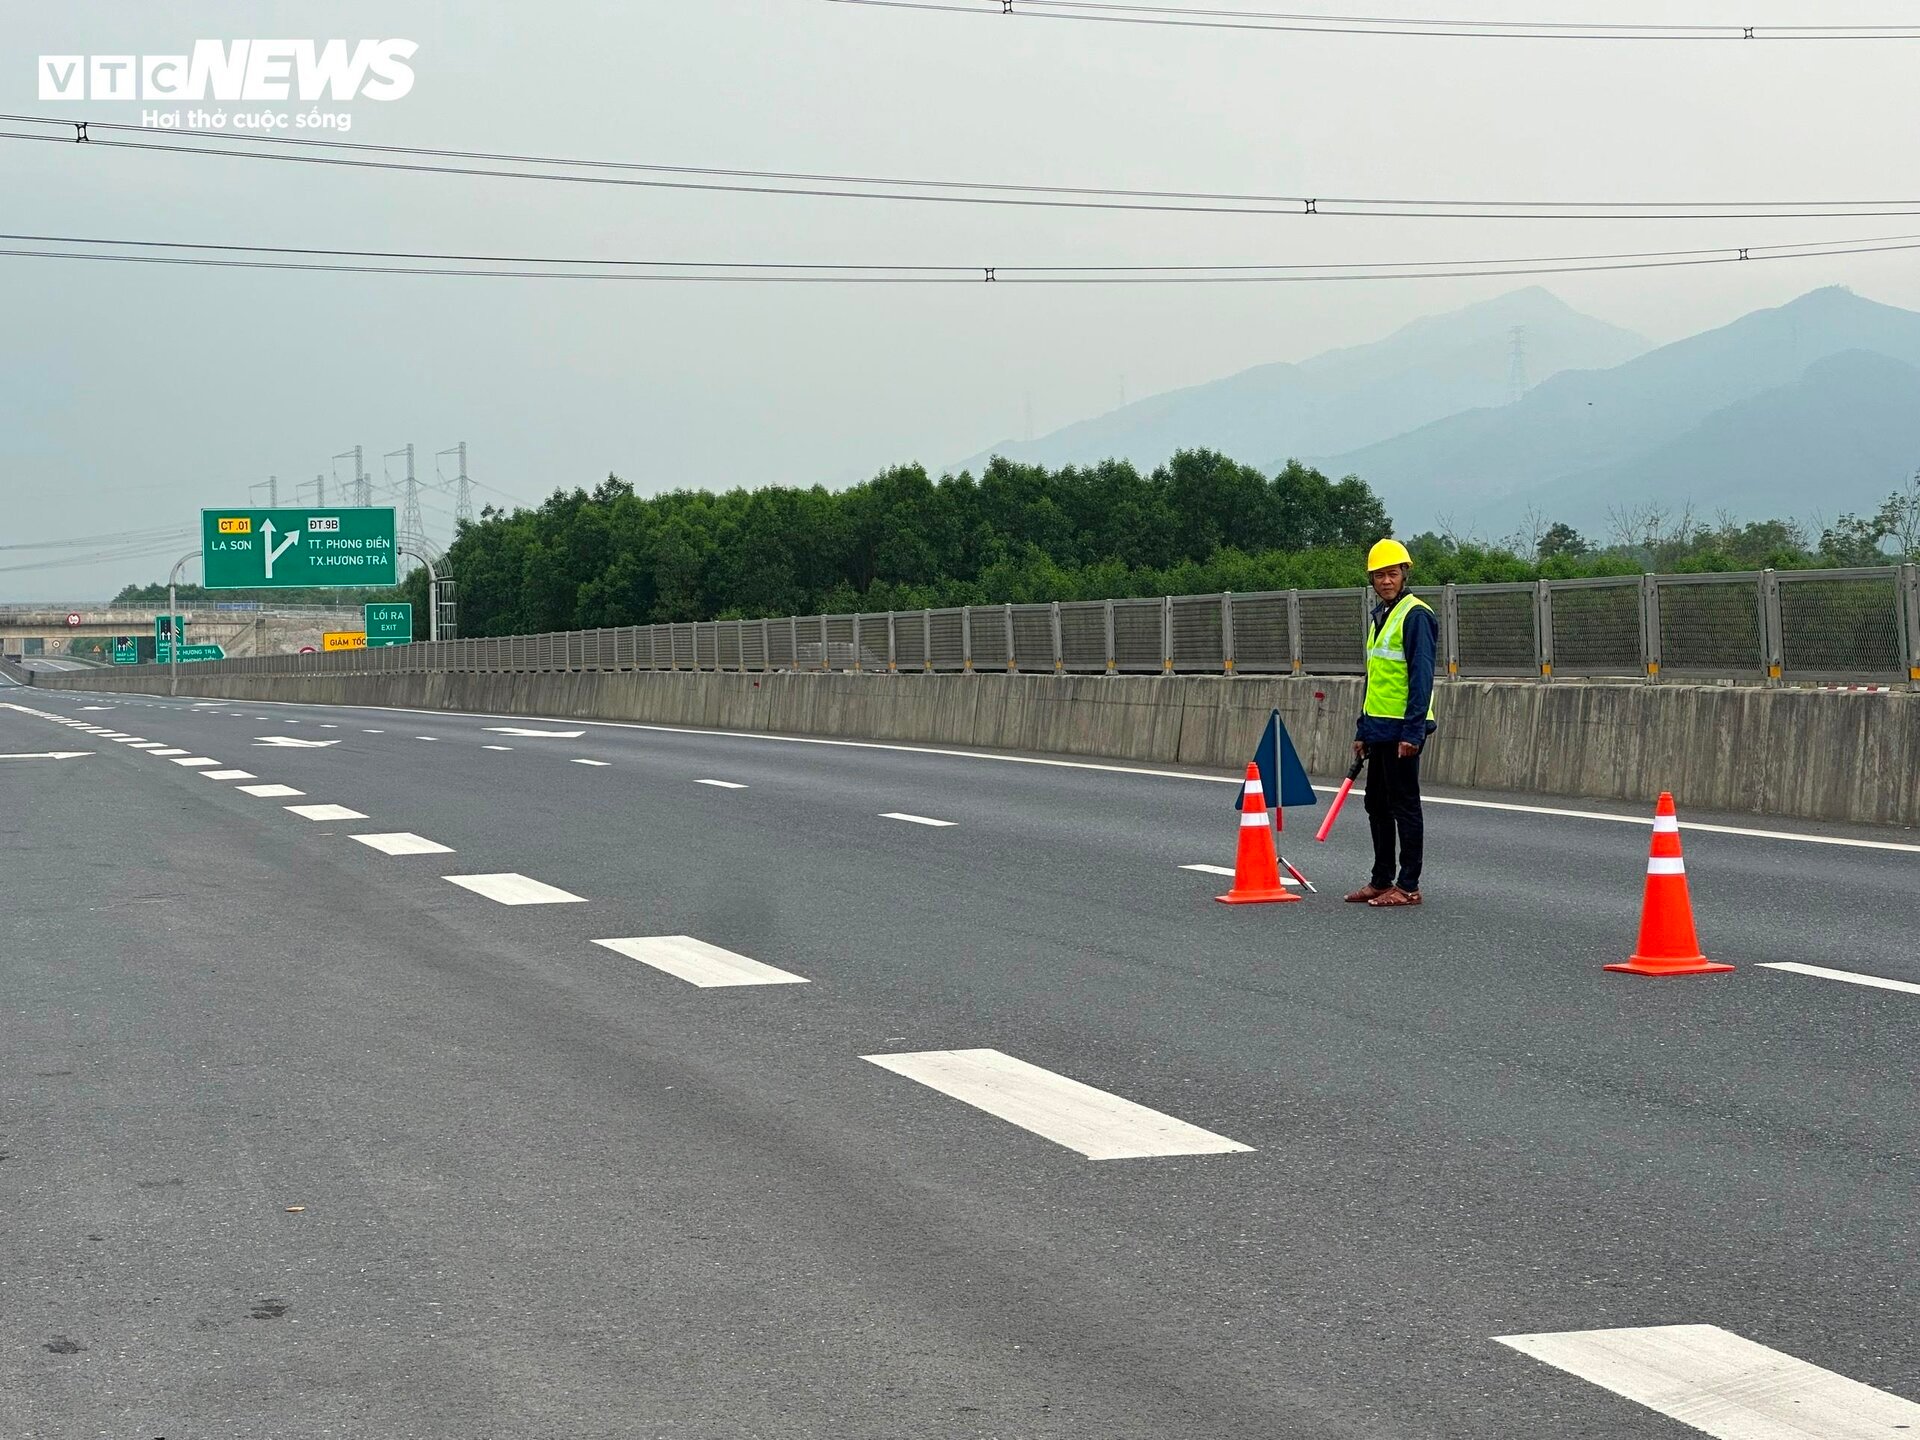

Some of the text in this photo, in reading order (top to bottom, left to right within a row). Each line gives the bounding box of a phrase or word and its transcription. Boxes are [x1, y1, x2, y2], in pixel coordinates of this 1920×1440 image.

[309, 520, 339, 530] ĐT.9B
[211, 540, 252, 551] LA SƠN
[308, 535, 390, 550] TT. PHONG ĐIỀN
[366, 552, 388, 565] TRÀ
[373, 607, 404, 620] LỐI RA
